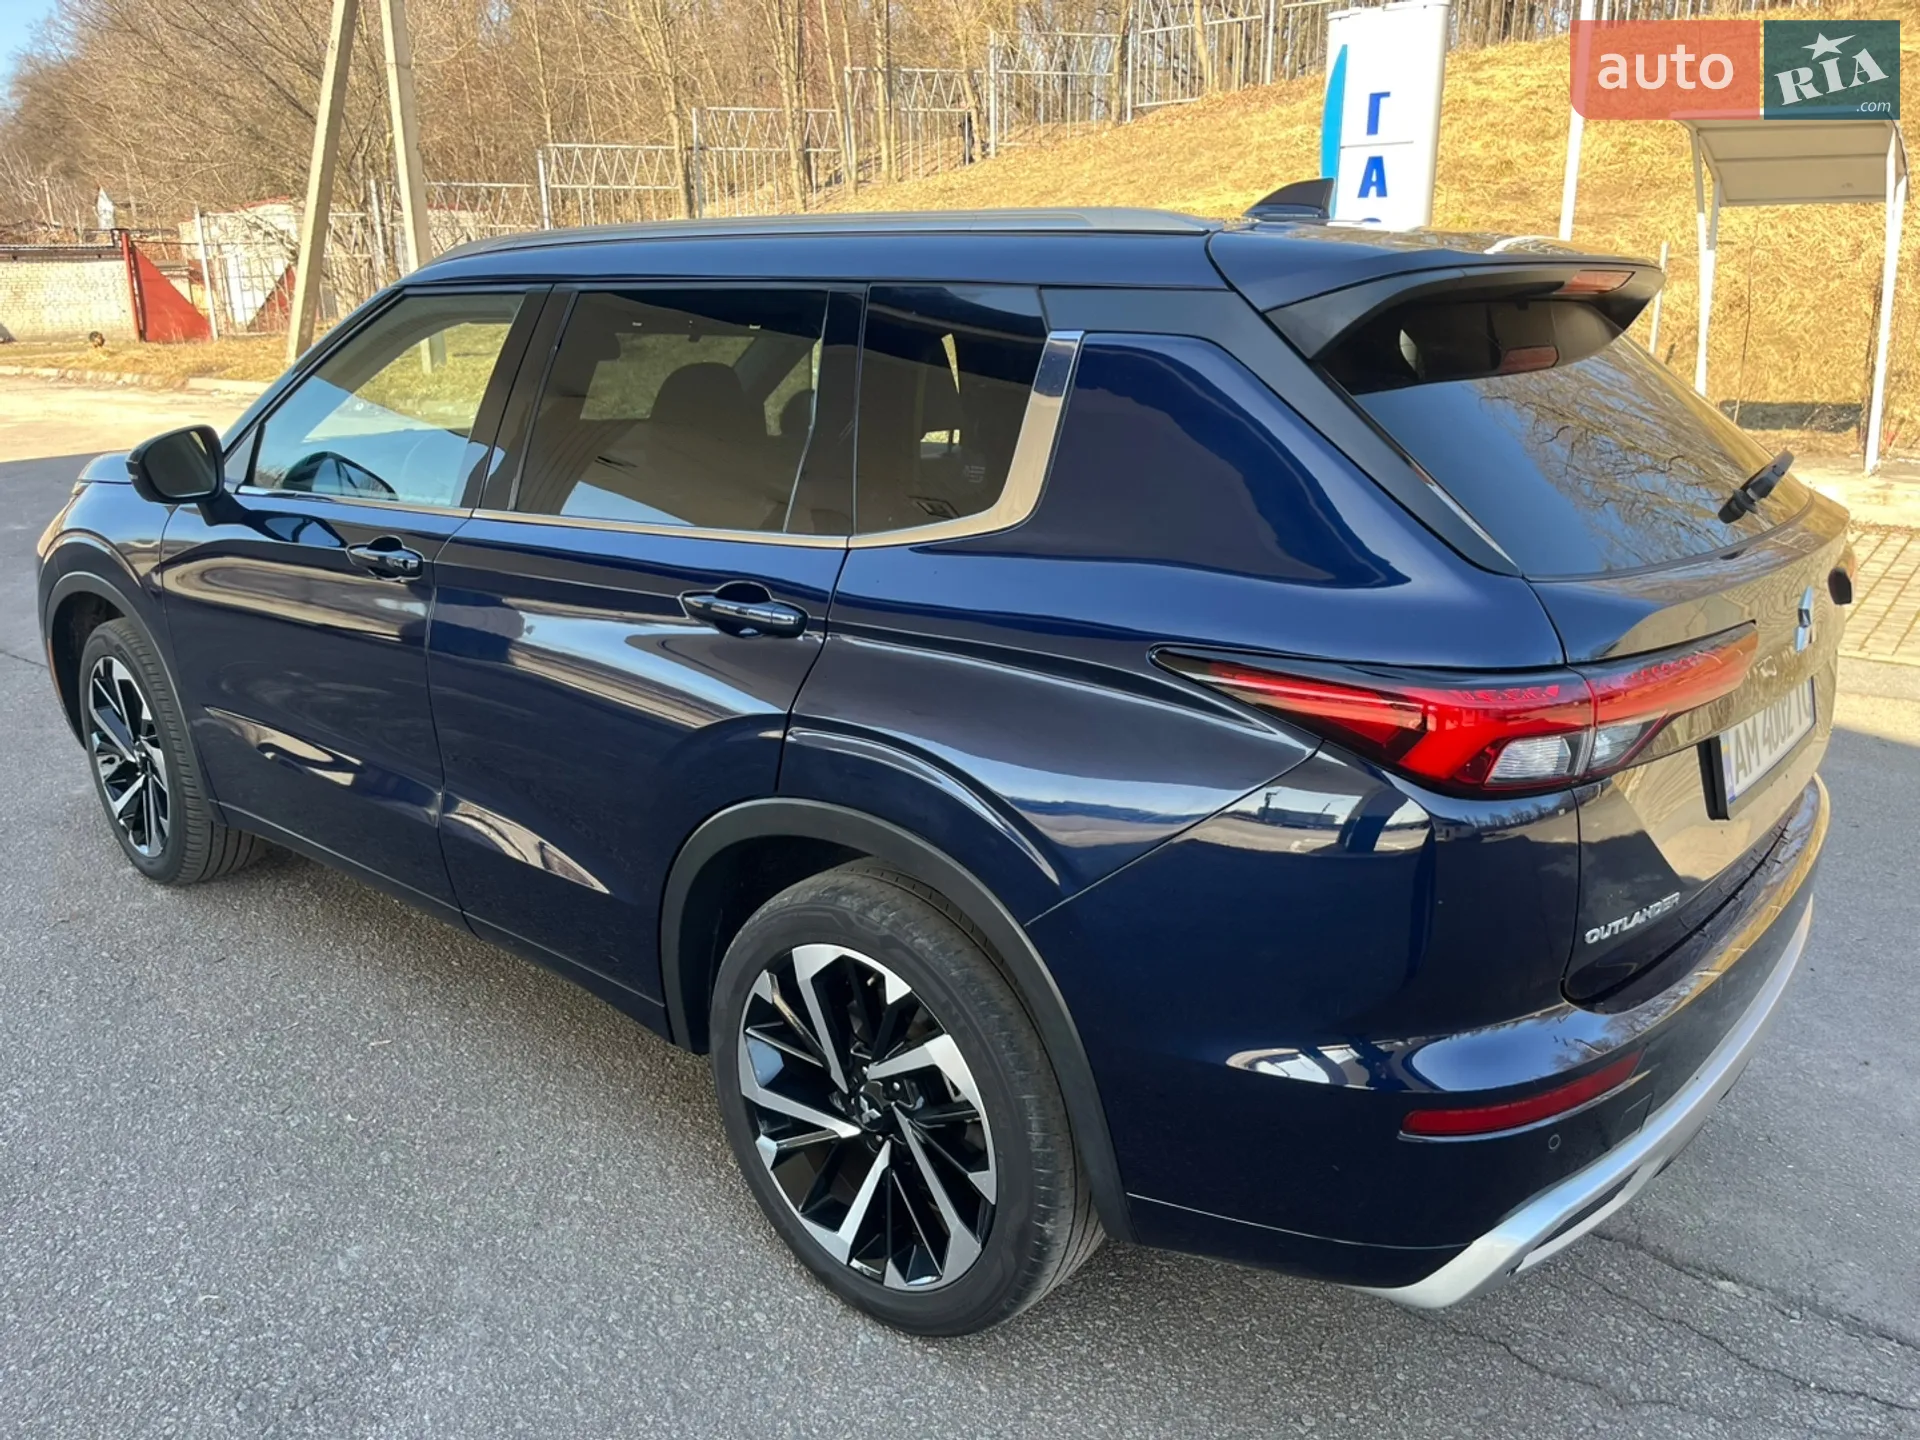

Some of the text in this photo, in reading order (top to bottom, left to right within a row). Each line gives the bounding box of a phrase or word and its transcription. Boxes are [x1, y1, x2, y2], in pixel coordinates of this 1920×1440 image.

[1357, 91, 1391, 223] ГА
[1735, 716, 1760, 785] AM
[1584, 891, 1680, 944] OUTLANDER
